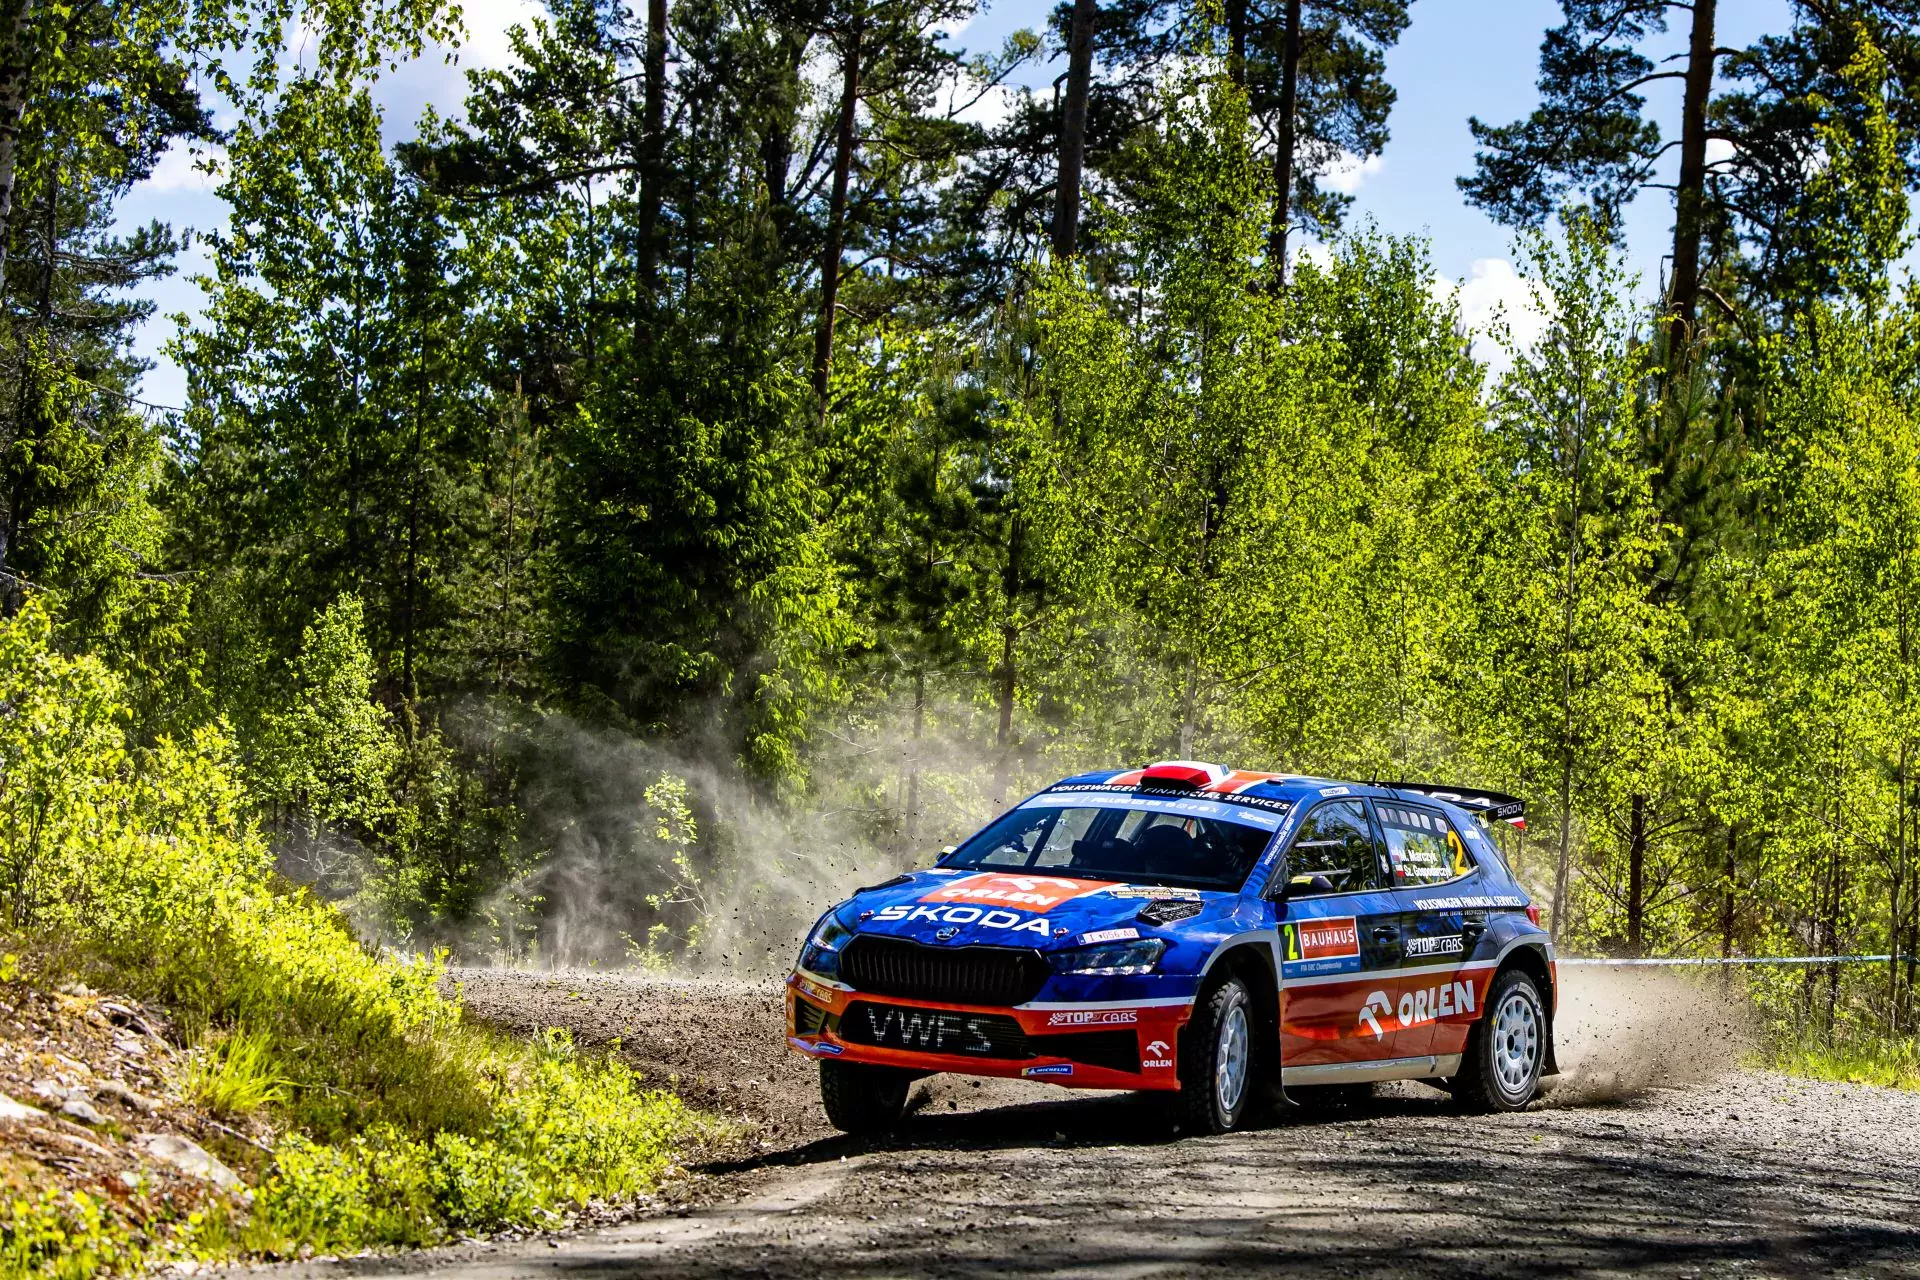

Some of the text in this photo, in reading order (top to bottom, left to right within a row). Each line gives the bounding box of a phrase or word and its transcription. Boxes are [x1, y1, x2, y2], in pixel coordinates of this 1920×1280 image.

[1051, 784, 1290, 810] VOLKSWAGEN FINANCIAL SERVICES
[1408, 850, 1438, 864] Marczyk
[1447, 830, 1469, 877] 2
[940, 888, 1060, 906] ORLEN
[1413, 895, 1522, 911] VOLKSWAGEN FINANCIAL SERVICES
[1284, 924, 1298, 960] 2
[1302, 929, 1355, 947] BAUHAUS
[1416, 937, 1434, 953] TOP
[1440, 938, 1464, 952] CARS
[1398, 979, 1475, 1027] ORLEN
[1066, 1012, 1138, 1023] TOP CARS
[868, 1007, 992, 1052] VWFS
[1142, 1059, 1172, 1067] ORLEN
